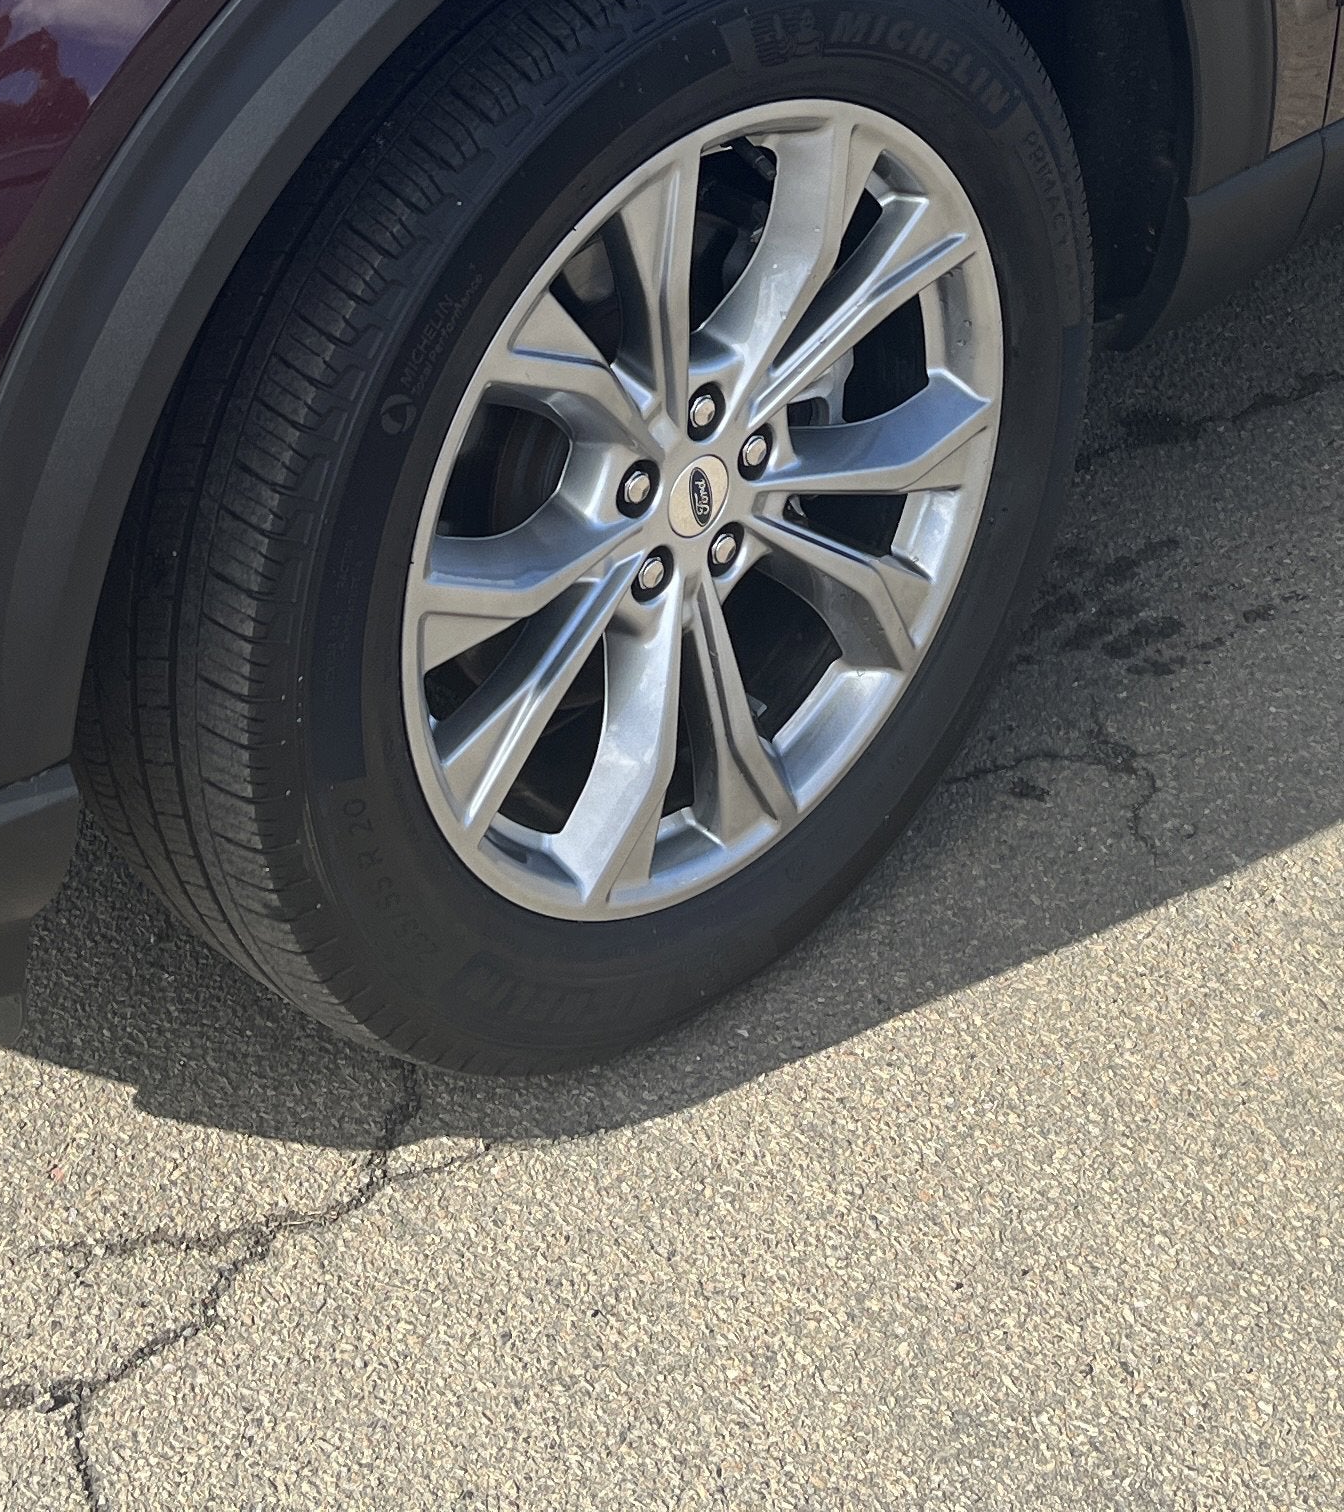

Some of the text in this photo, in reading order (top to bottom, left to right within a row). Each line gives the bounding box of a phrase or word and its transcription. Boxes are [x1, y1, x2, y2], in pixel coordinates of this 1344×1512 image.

[830, 10, 1014, 116] MICHELIN
[400, 293, 454, 387] MICHELIN
[694, 478, 710, 516] Ford
